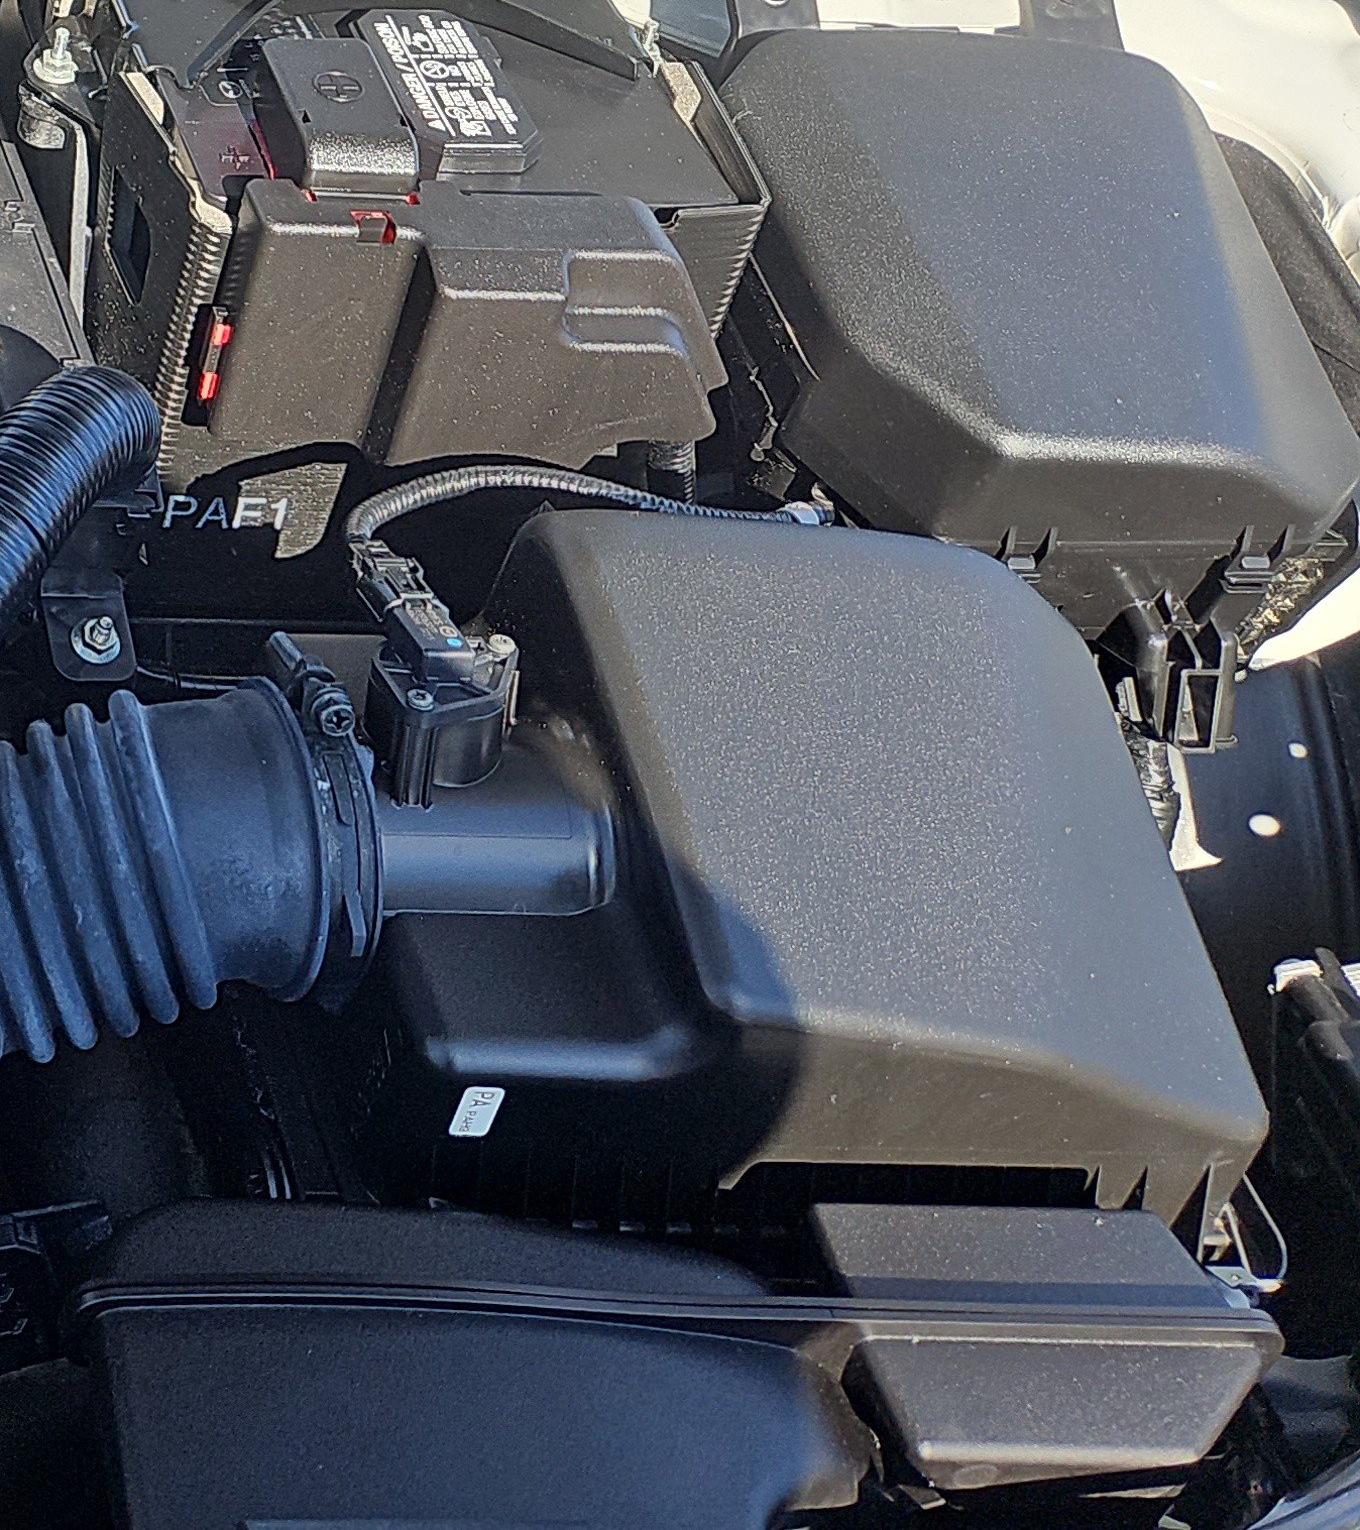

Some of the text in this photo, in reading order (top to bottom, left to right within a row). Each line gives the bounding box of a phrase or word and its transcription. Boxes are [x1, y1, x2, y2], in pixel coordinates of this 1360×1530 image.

[373, 22, 409, 64] POISON
[401, 73, 440, 119] DANGER
[162, 495, 288, 530] PAF1
[469, 1091, 495, 1108] PA
